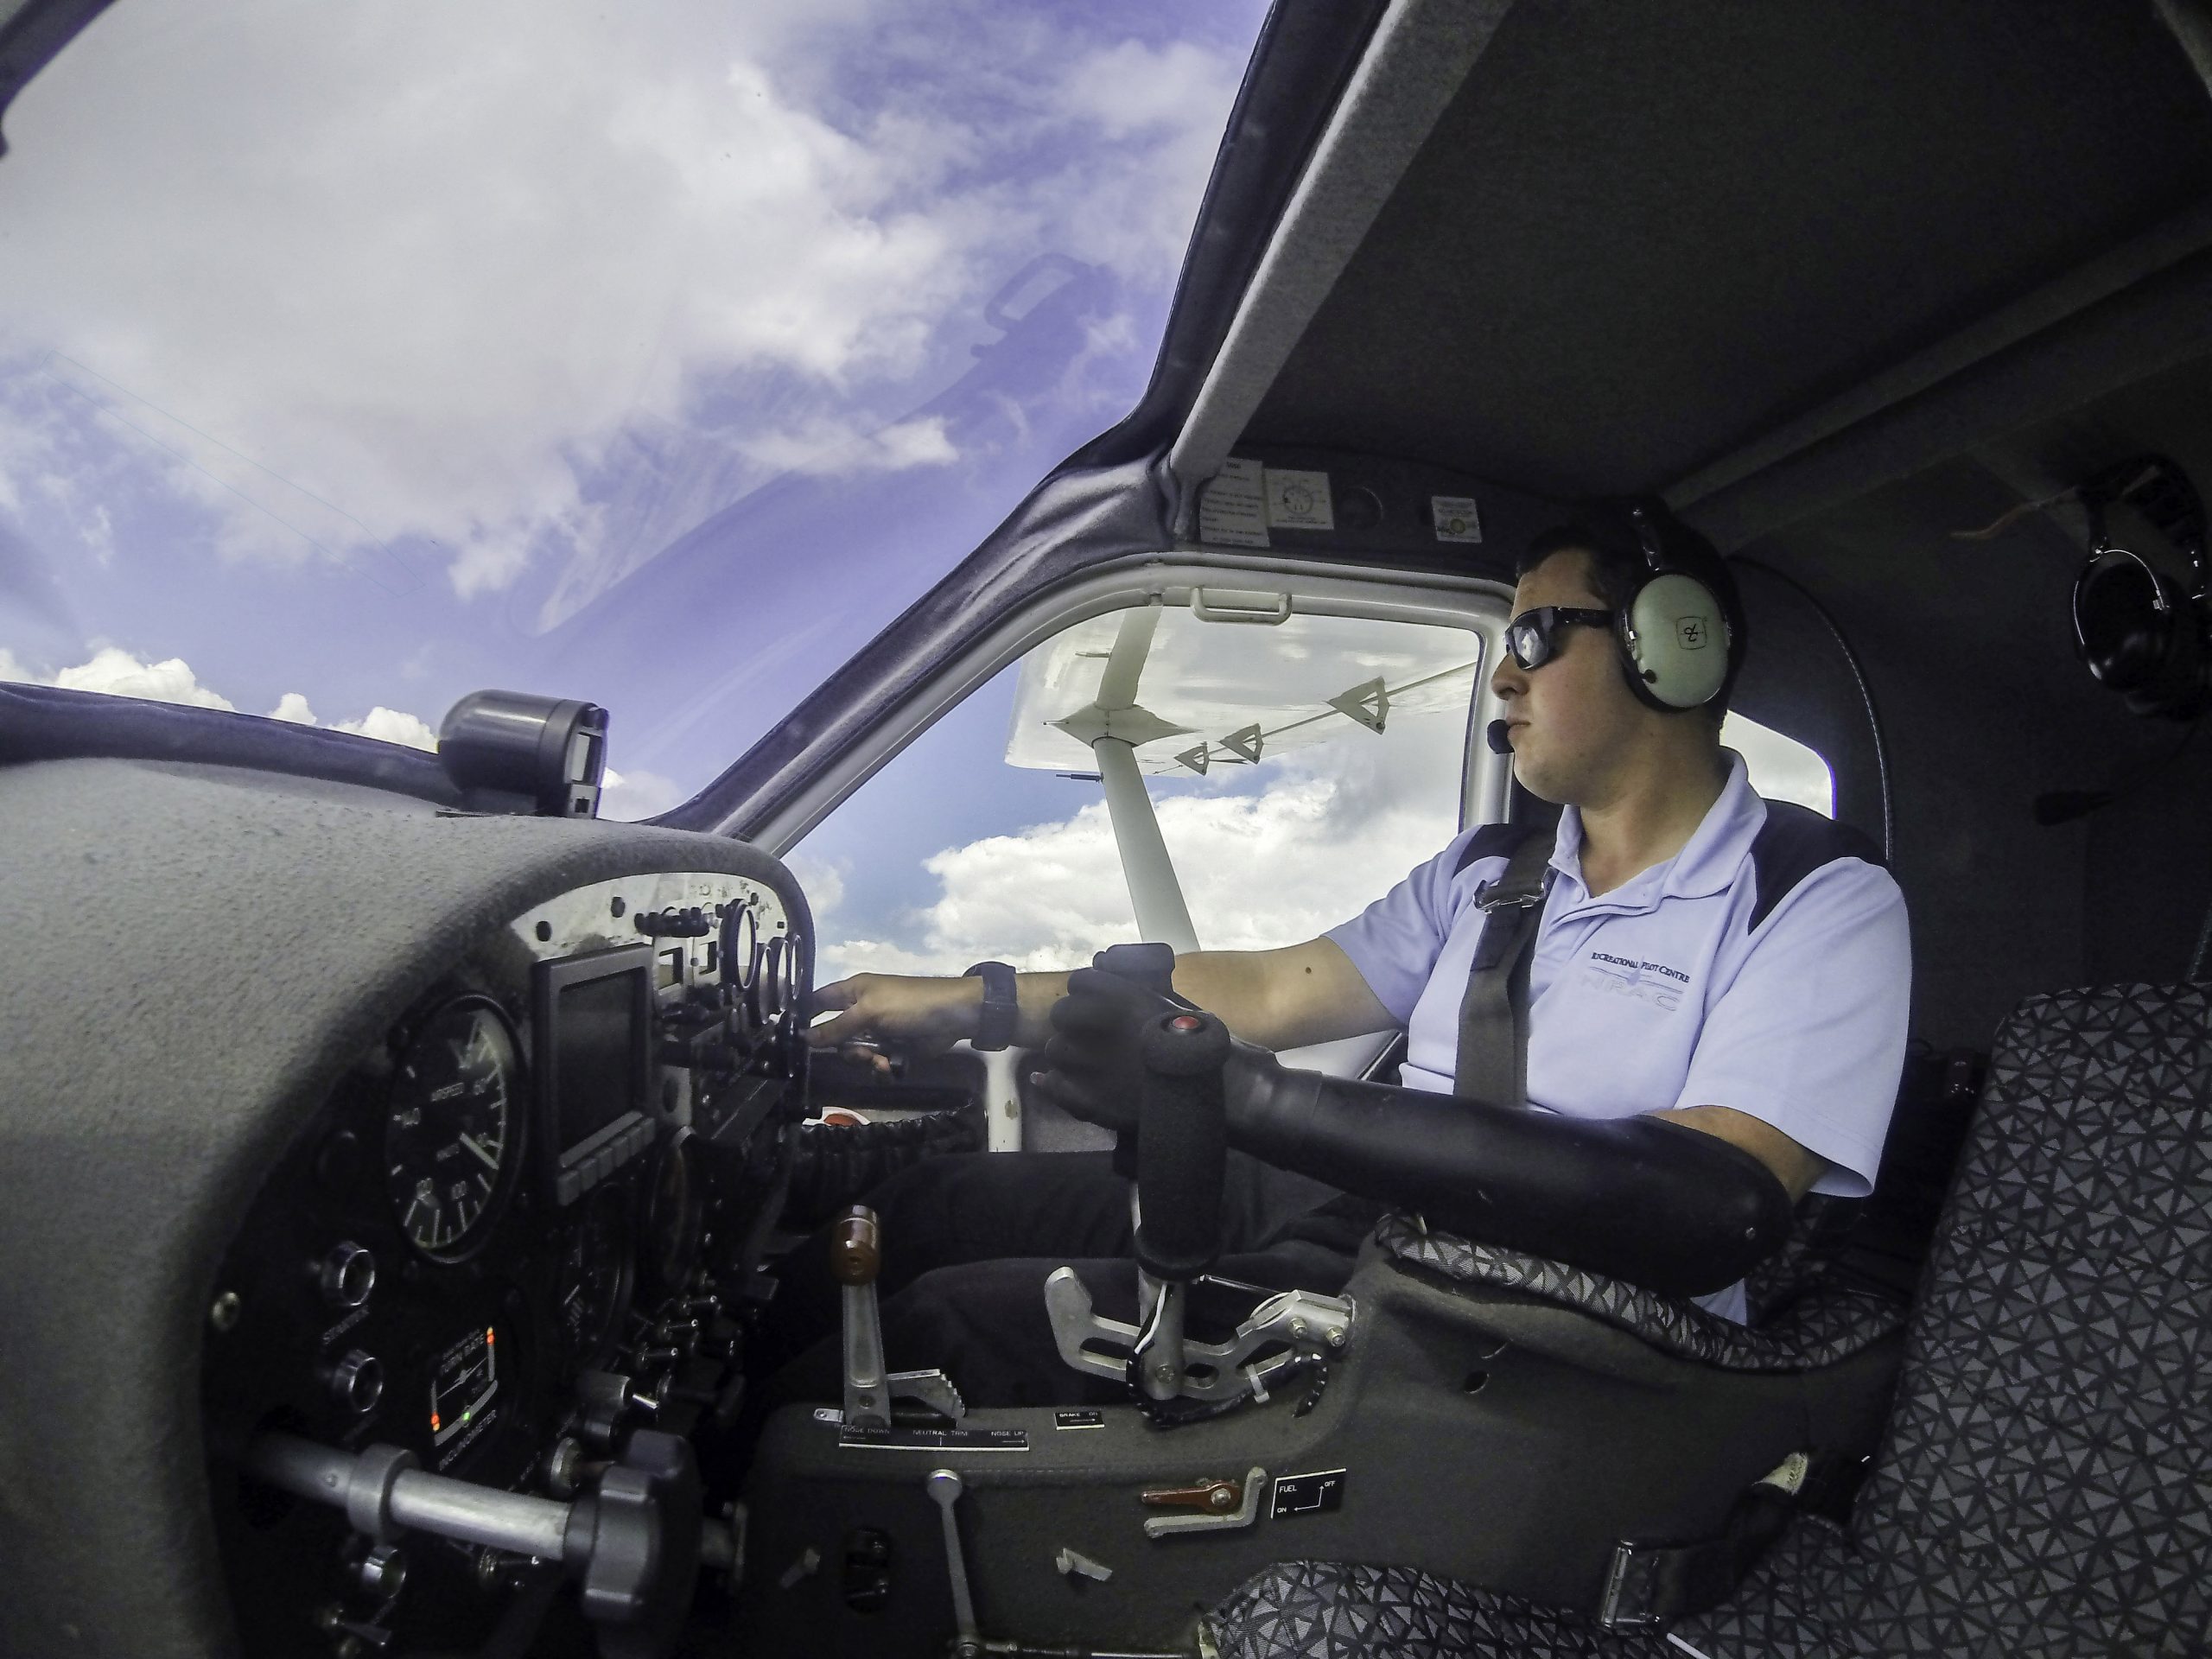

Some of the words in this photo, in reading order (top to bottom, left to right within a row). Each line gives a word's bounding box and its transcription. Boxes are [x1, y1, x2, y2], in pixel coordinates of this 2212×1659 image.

[1641, 962, 1660, 971] PILOT
[1659, 966, 1690, 983] CENTRE
[1279, 1484, 1297, 1494] FUEL
